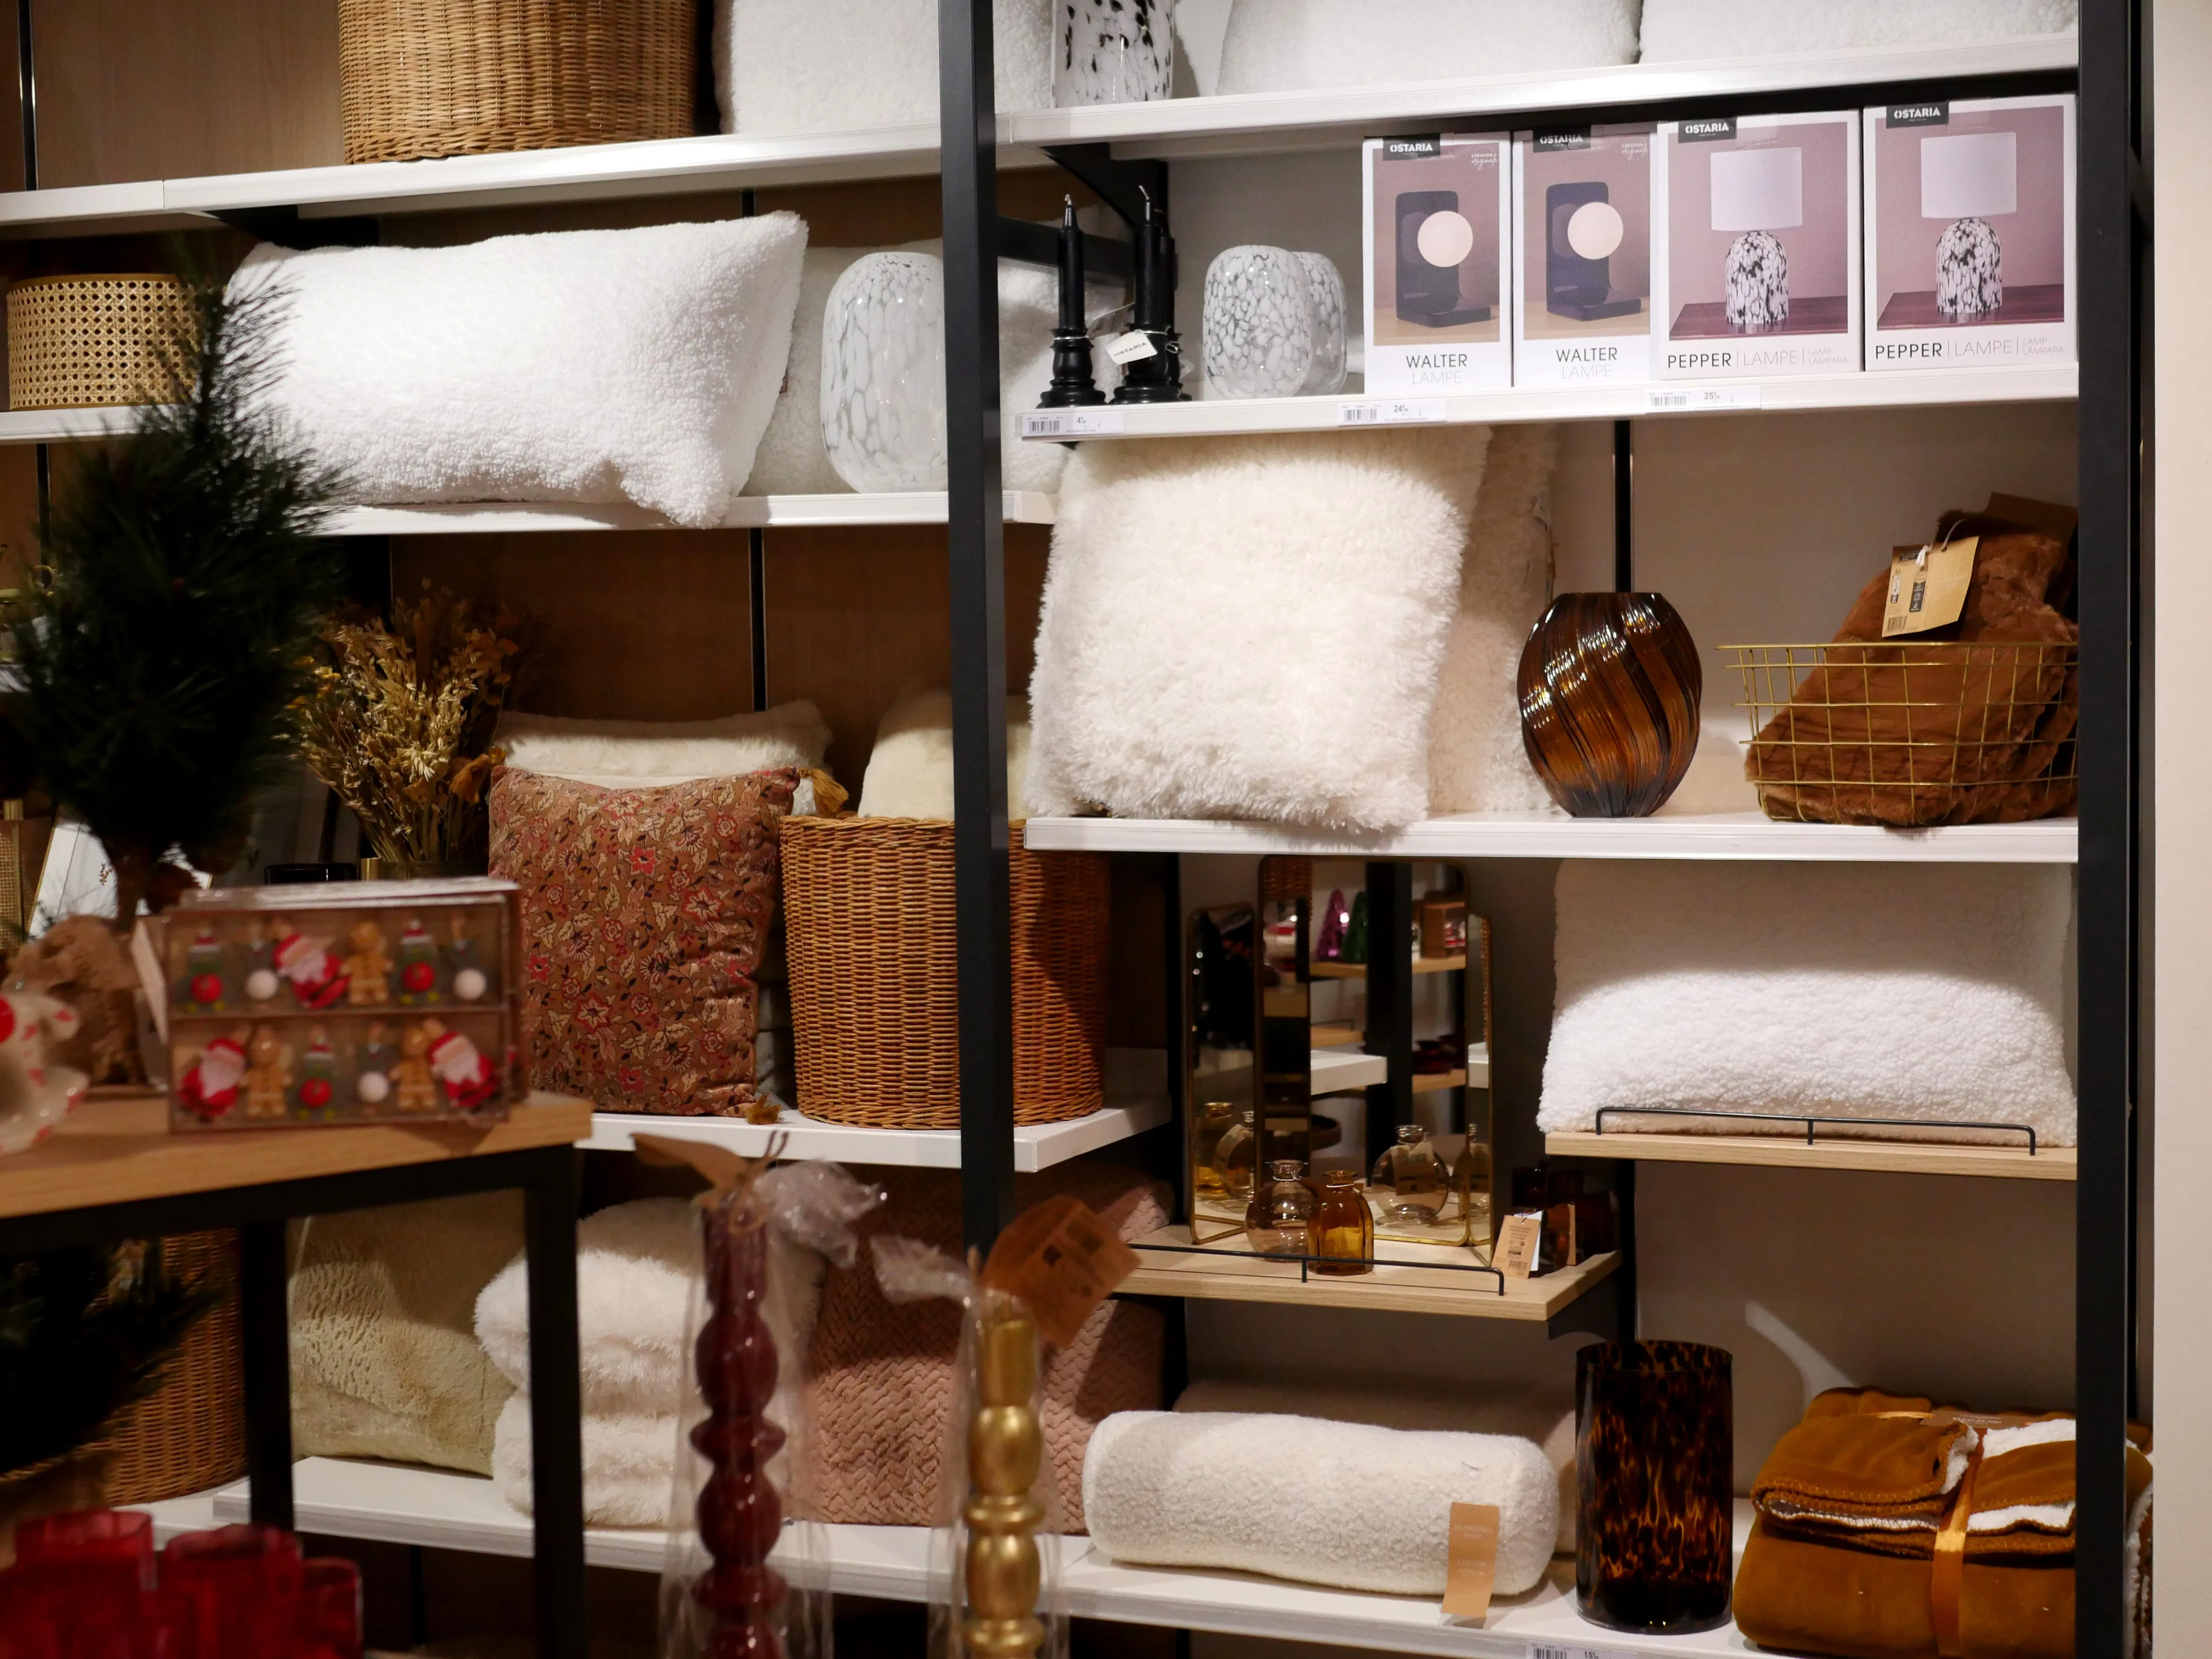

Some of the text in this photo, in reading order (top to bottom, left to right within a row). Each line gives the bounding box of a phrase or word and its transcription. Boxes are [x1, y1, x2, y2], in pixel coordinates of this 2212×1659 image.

[1894, 107, 1941, 119] OSTARIA
[1684, 122, 1729, 134] OSTARIA
[1539, 134, 1583, 144] OSTARIA
[1390, 143, 1433, 153] OSTARIA
[2022, 337, 2047, 346] LAMP
[1114, 342, 1147, 357] OSTARIA
[1556, 347, 1618, 362] WALTER
[1808, 348, 1832, 356] LAMP
[1875, 340, 2012, 359] PEPPER LAMPE
[1406, 354, 1467, 369] WALTER
[1668, 350, 1798, 369] PEPPER LAMPE
[1412, 371, 1462, 385] LAMPE
[1562, 365, 1612, 379] LAMPE
